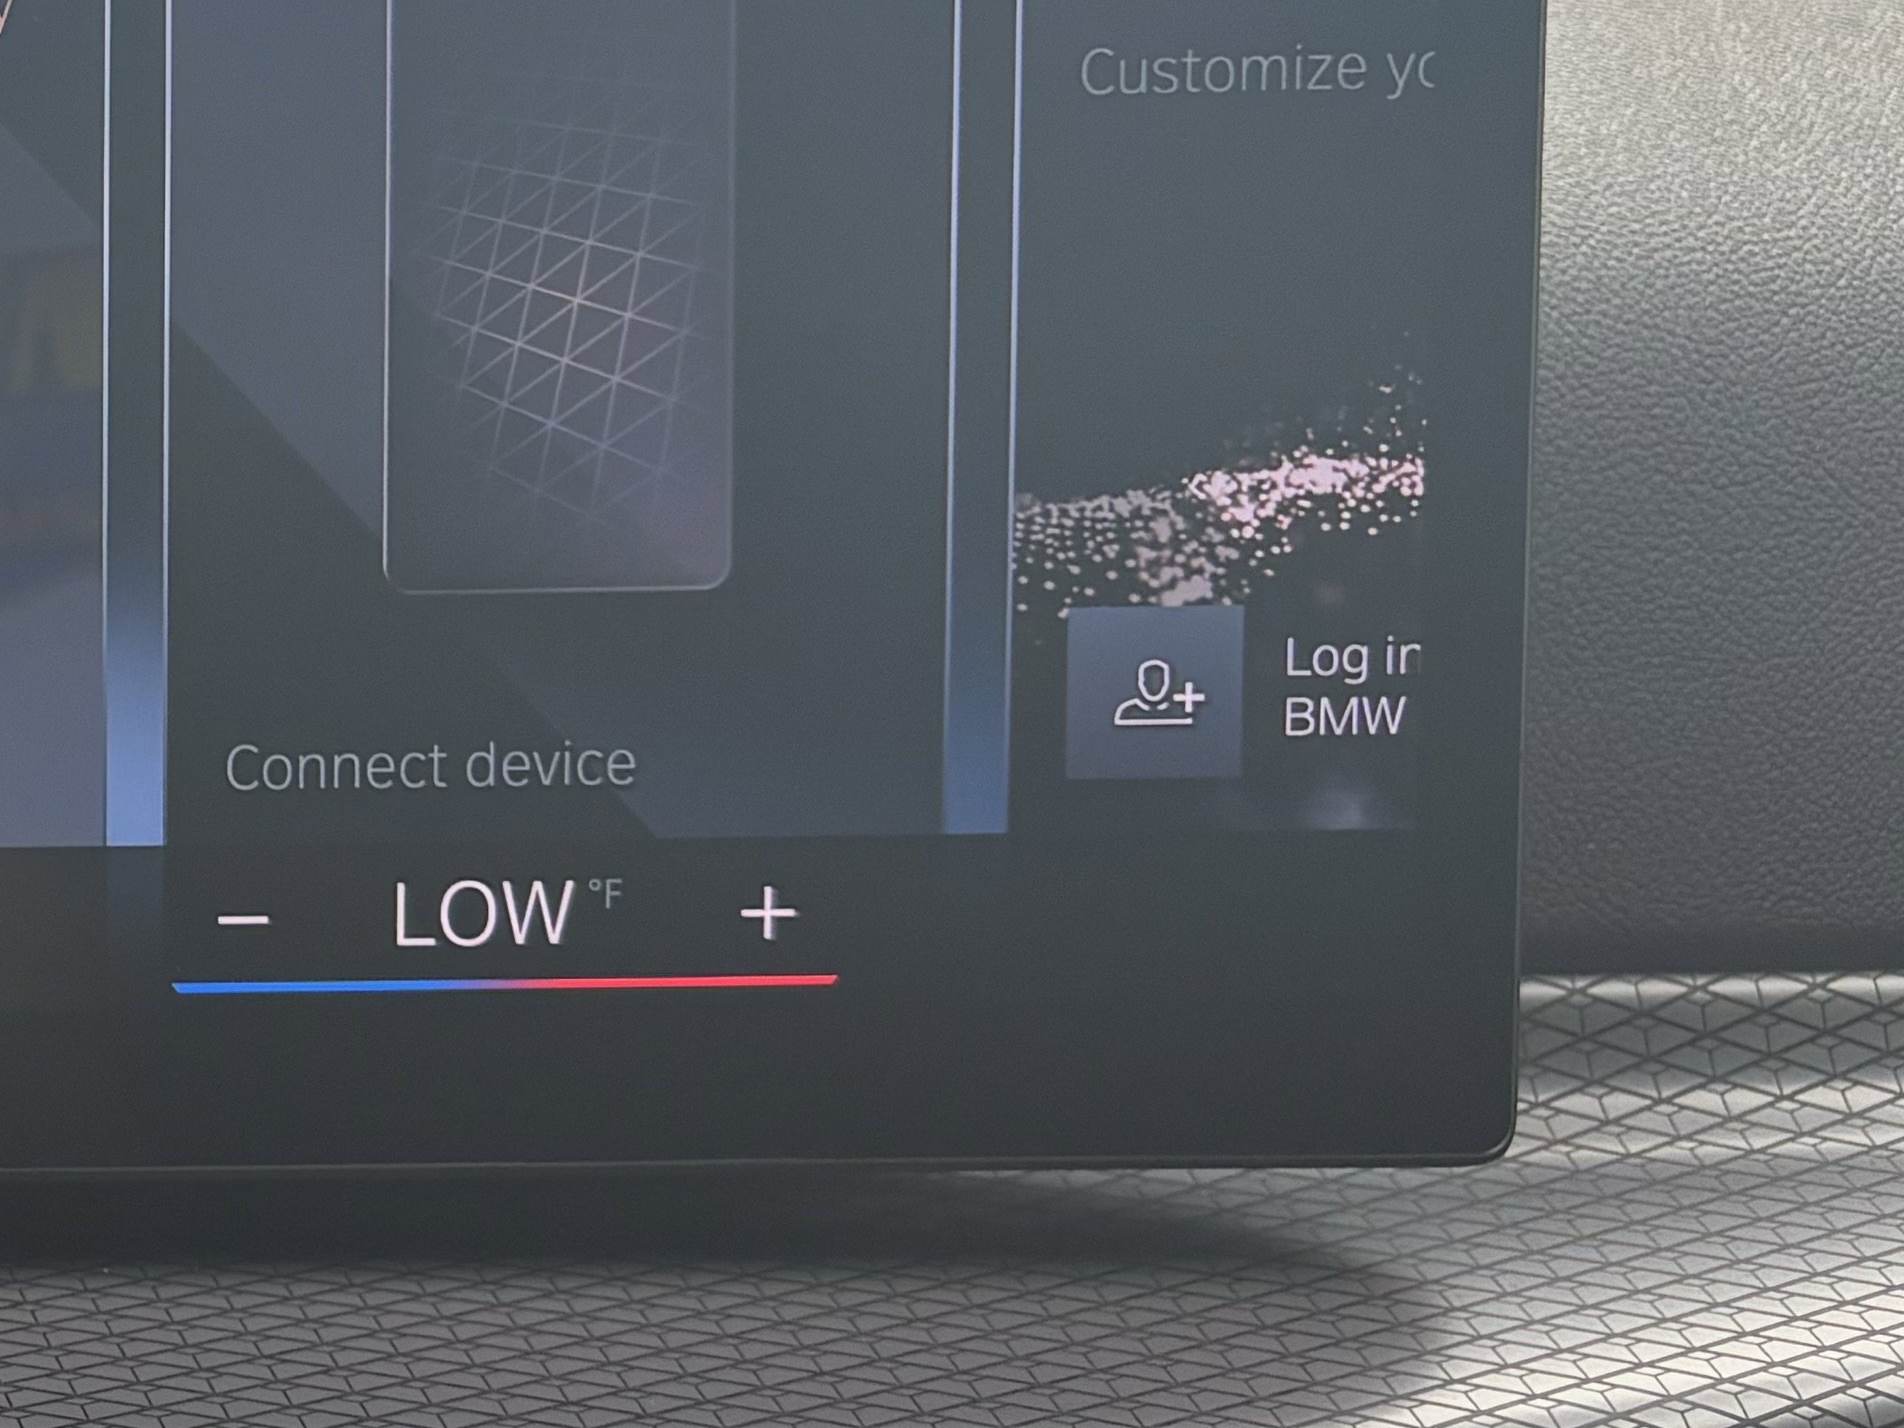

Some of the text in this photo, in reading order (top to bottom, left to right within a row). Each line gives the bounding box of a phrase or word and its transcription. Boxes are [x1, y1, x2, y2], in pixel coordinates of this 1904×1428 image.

[1080, 44, 1367, 96] Customize
[1286, 636, 1369, 685] Log
[1285, 695, 1407, 736] BMW
[225, 739, 637, 791] Connect device
[395, 878, 576, 947] LOW
